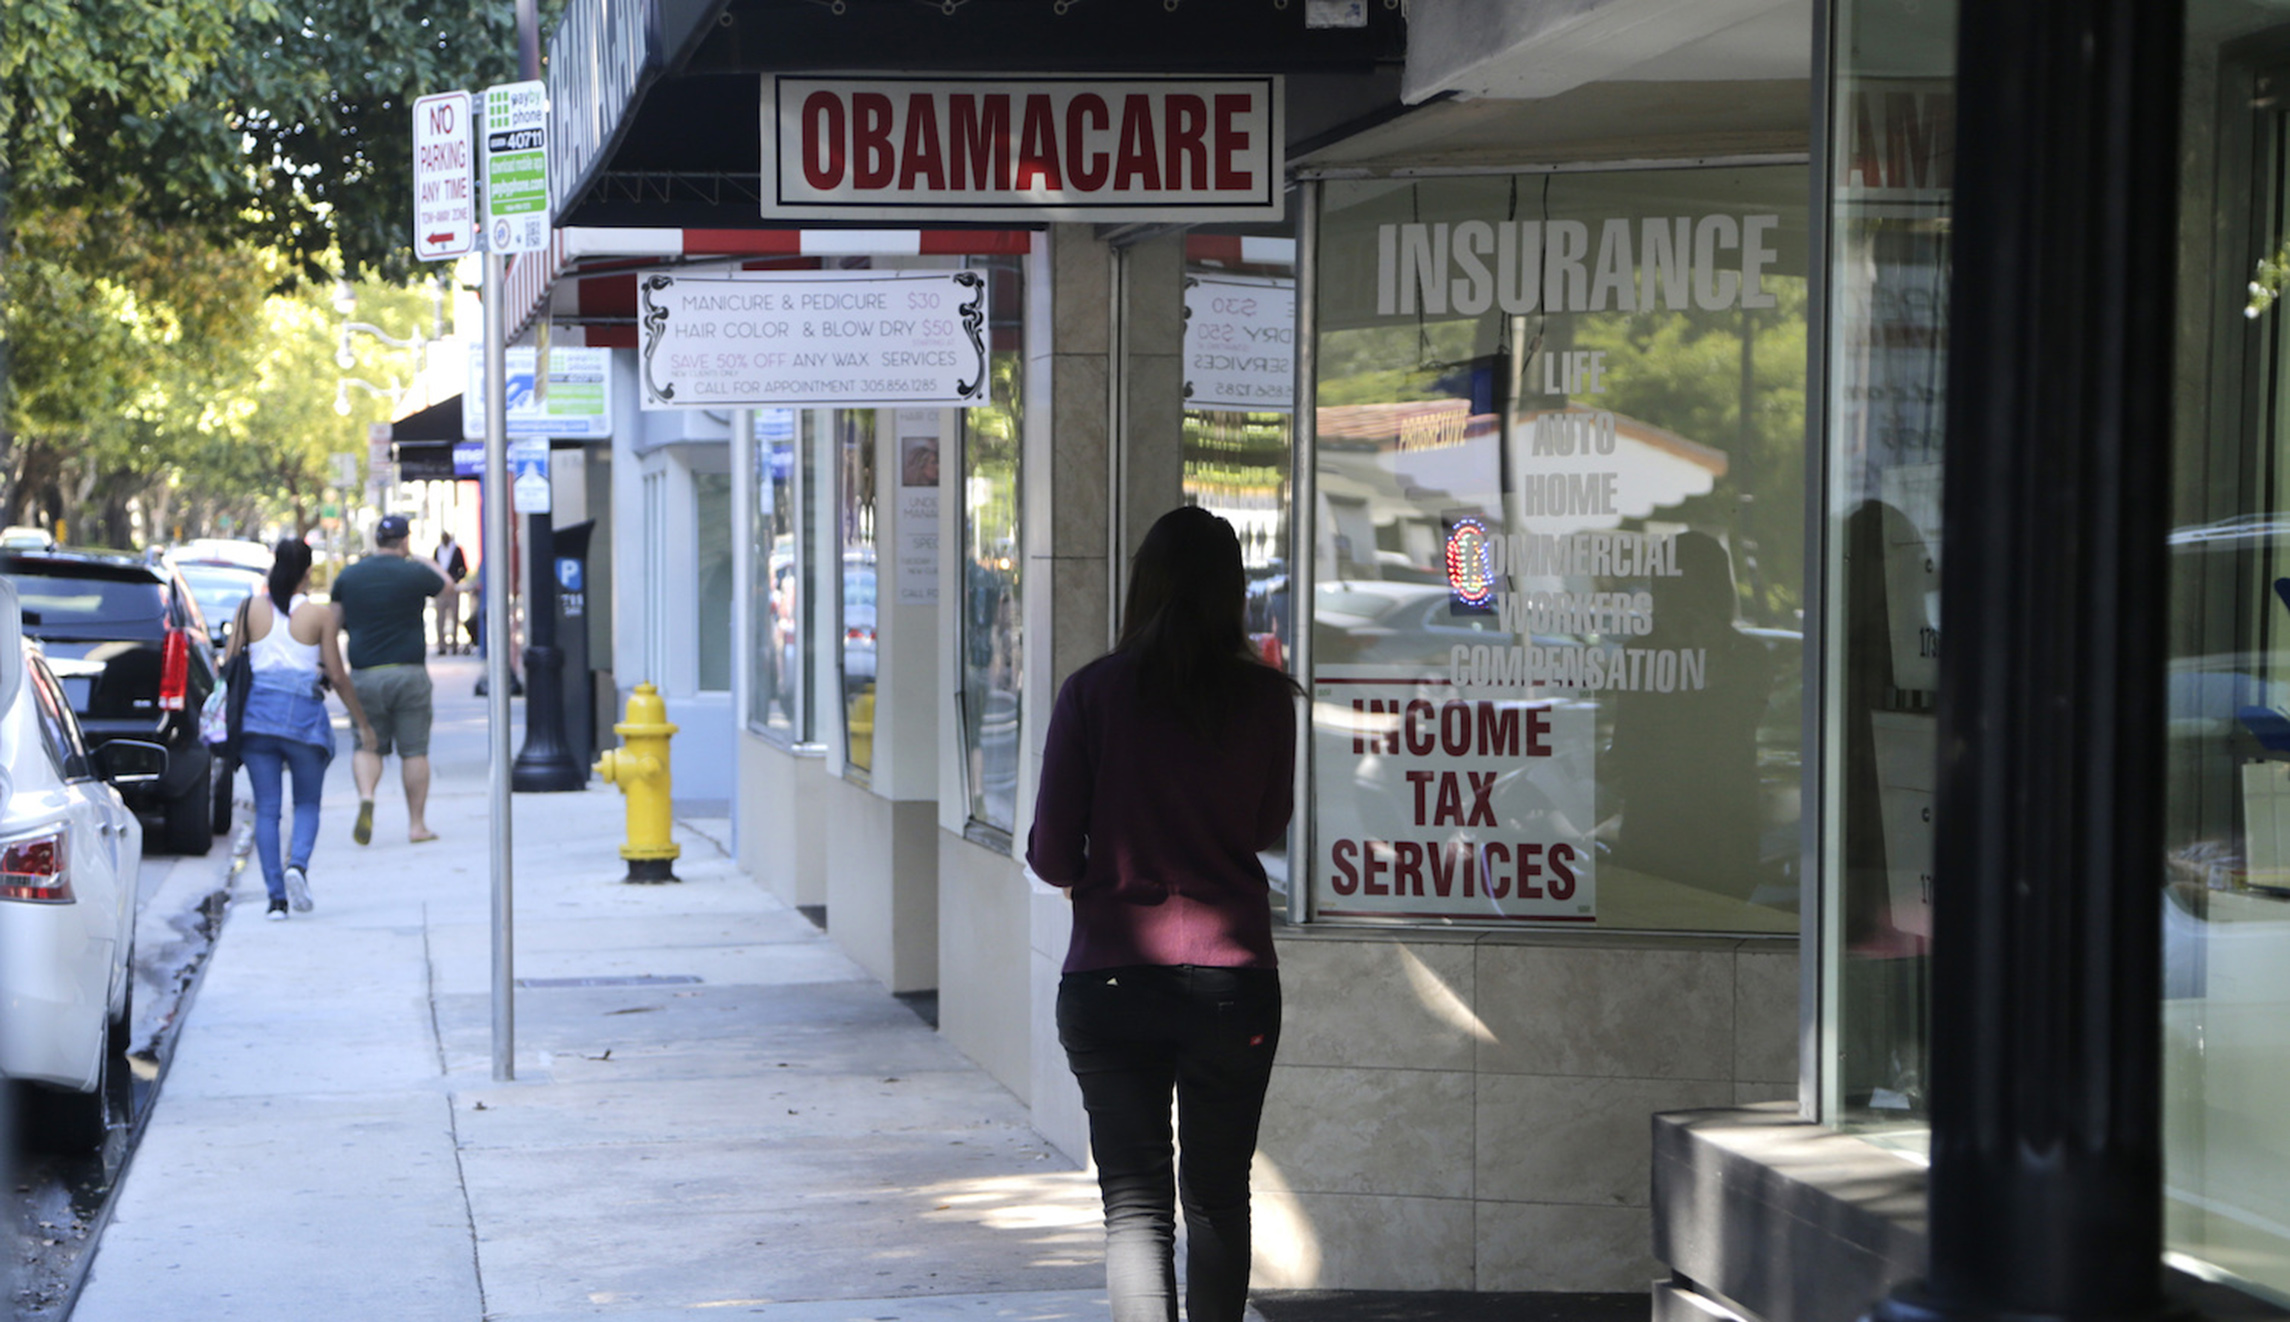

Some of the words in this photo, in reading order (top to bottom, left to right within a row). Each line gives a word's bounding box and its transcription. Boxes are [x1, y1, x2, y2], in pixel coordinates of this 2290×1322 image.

[429, 103, 455, 136] NO
[507, 131, 543, 151] 40711
[801, 90, 1253, 192] OBAMACARE
[421, 140, 466, 173] PARKING
[422, 180, 441, 204] ANY
[444, 177, 467, 201] TIME
[452, 207, 468, 222] ZONE
[1377, 214, 1779, 315] INSURANCE
[682, 294, 774, 312] MANICURE
[782, 294, 795, 311] &
[802, 293, 887, 310] PEDICURE
[907, 291, 940, 311] $30
[675, 322, 716, 339] HAIR
[723, 321, 789, 339] COLOR
[803, 322, 816, 338] &
[822, 320, 875, 338] BLOW
[880, 320, 916, 337] DRY
[922, 318, 954, 337] $50
[671, 353, 710, 370] SAVE
[716, 353, 748, 369] 50%
[753, 352, 787, 369] OFF
[792, 352, 828, 368] ANY
[832, 352, 870, 368] WAX
[881, 351, 957, 368] SERVICES
[1543, 350, 1607, 396] LIFE
[694, 380, 727, 395] CALL
[733, 380, 760, 394] FOR
[764, 379, 854, 394] APPOINTMENT
[860, 378, 938, 394] 305.856.1285
[1531, 410, 1616, 457] AUTO
[1525, 472, 1618, 517] HOME
[561, 560, 580, 587] P
[1465, 532, 1683, 579] COMMERCIAL
[1498, 592, 1653, 637] WORKERS
[1450, 643, 1706, 693] COMPENSATION
[1353, 699, 1553, 757] INCOME
[1406, 771, 1498, 827] TAX
[1331, 838, 1576, 901] SERVICES
